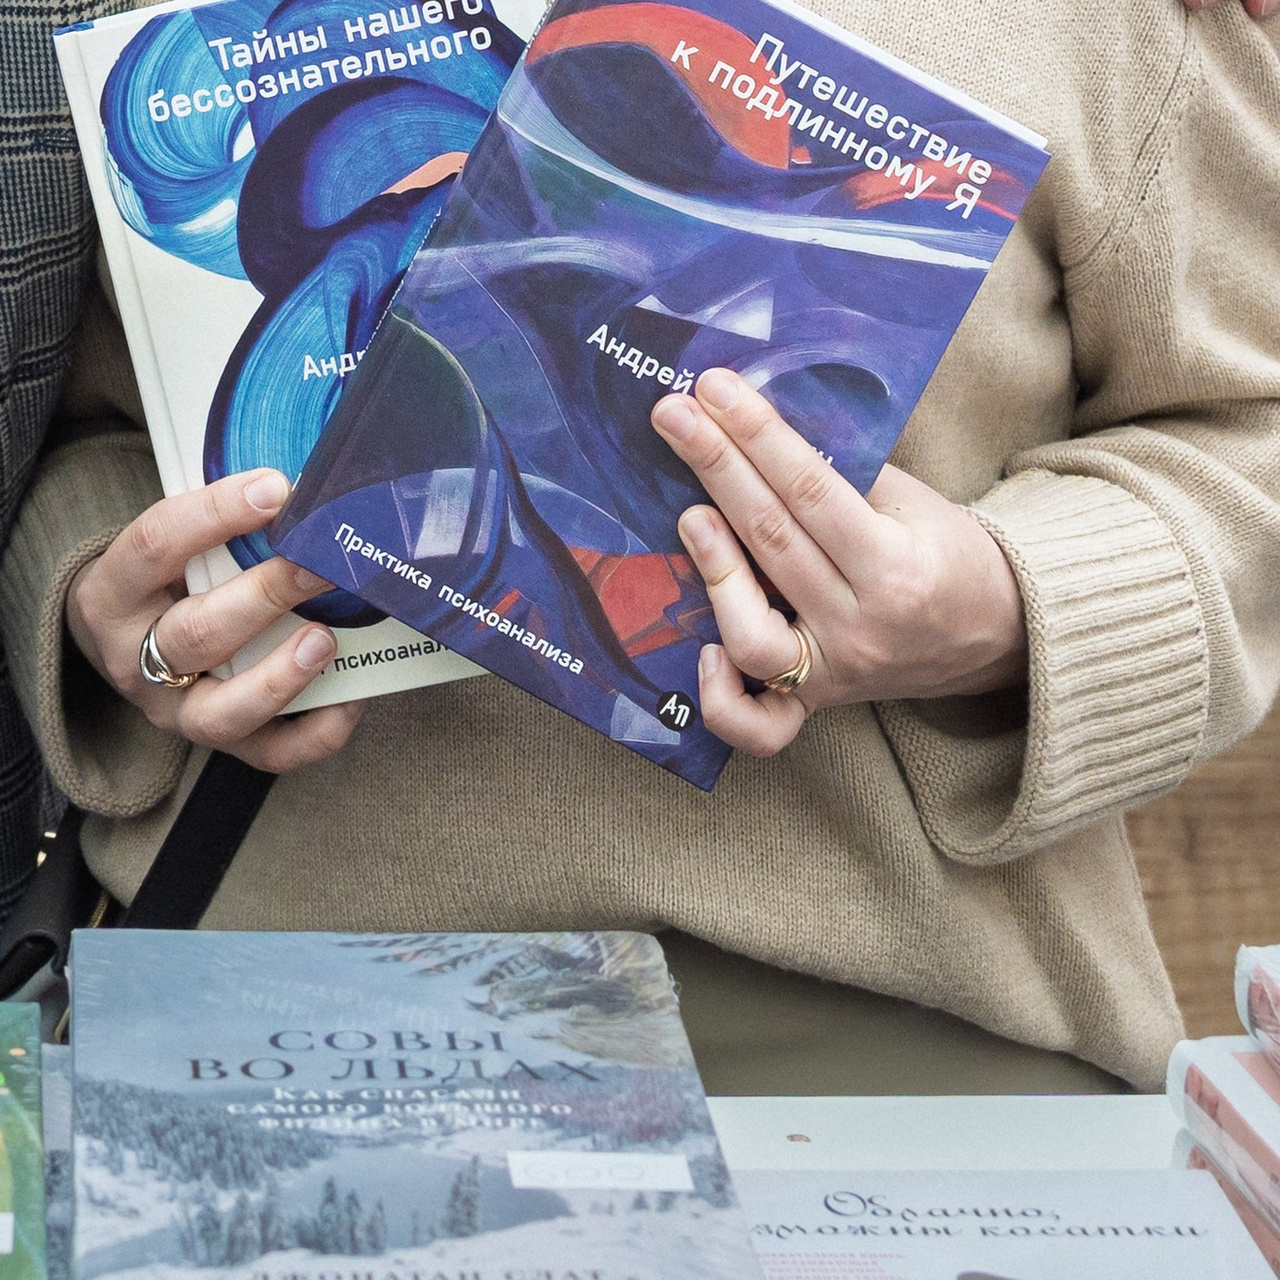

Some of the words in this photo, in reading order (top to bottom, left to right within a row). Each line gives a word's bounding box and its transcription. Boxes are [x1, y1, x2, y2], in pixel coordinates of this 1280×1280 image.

[148, 26, 493, 123] бессознательного
[209, 29, 327, 73] Тайны
[671, 40, 700, 70] к
[708, 60, 937, 200] подлинному
[945, 182, 982, 220] Я
[749, 32, 992, 186] Путешествие
[586, 323, 696, 395] Андрей
[334, 522, 433, 590] Практика
[438, 584, 585, 675] психоанализа
[188, 1058, 295, 1080] ВО
[331, 1059, 601, 1084] ЛЬДАХ
[269, 1030, 506, 1051] СОВЫ
[978, 1224, 1209, 1238] косатки
